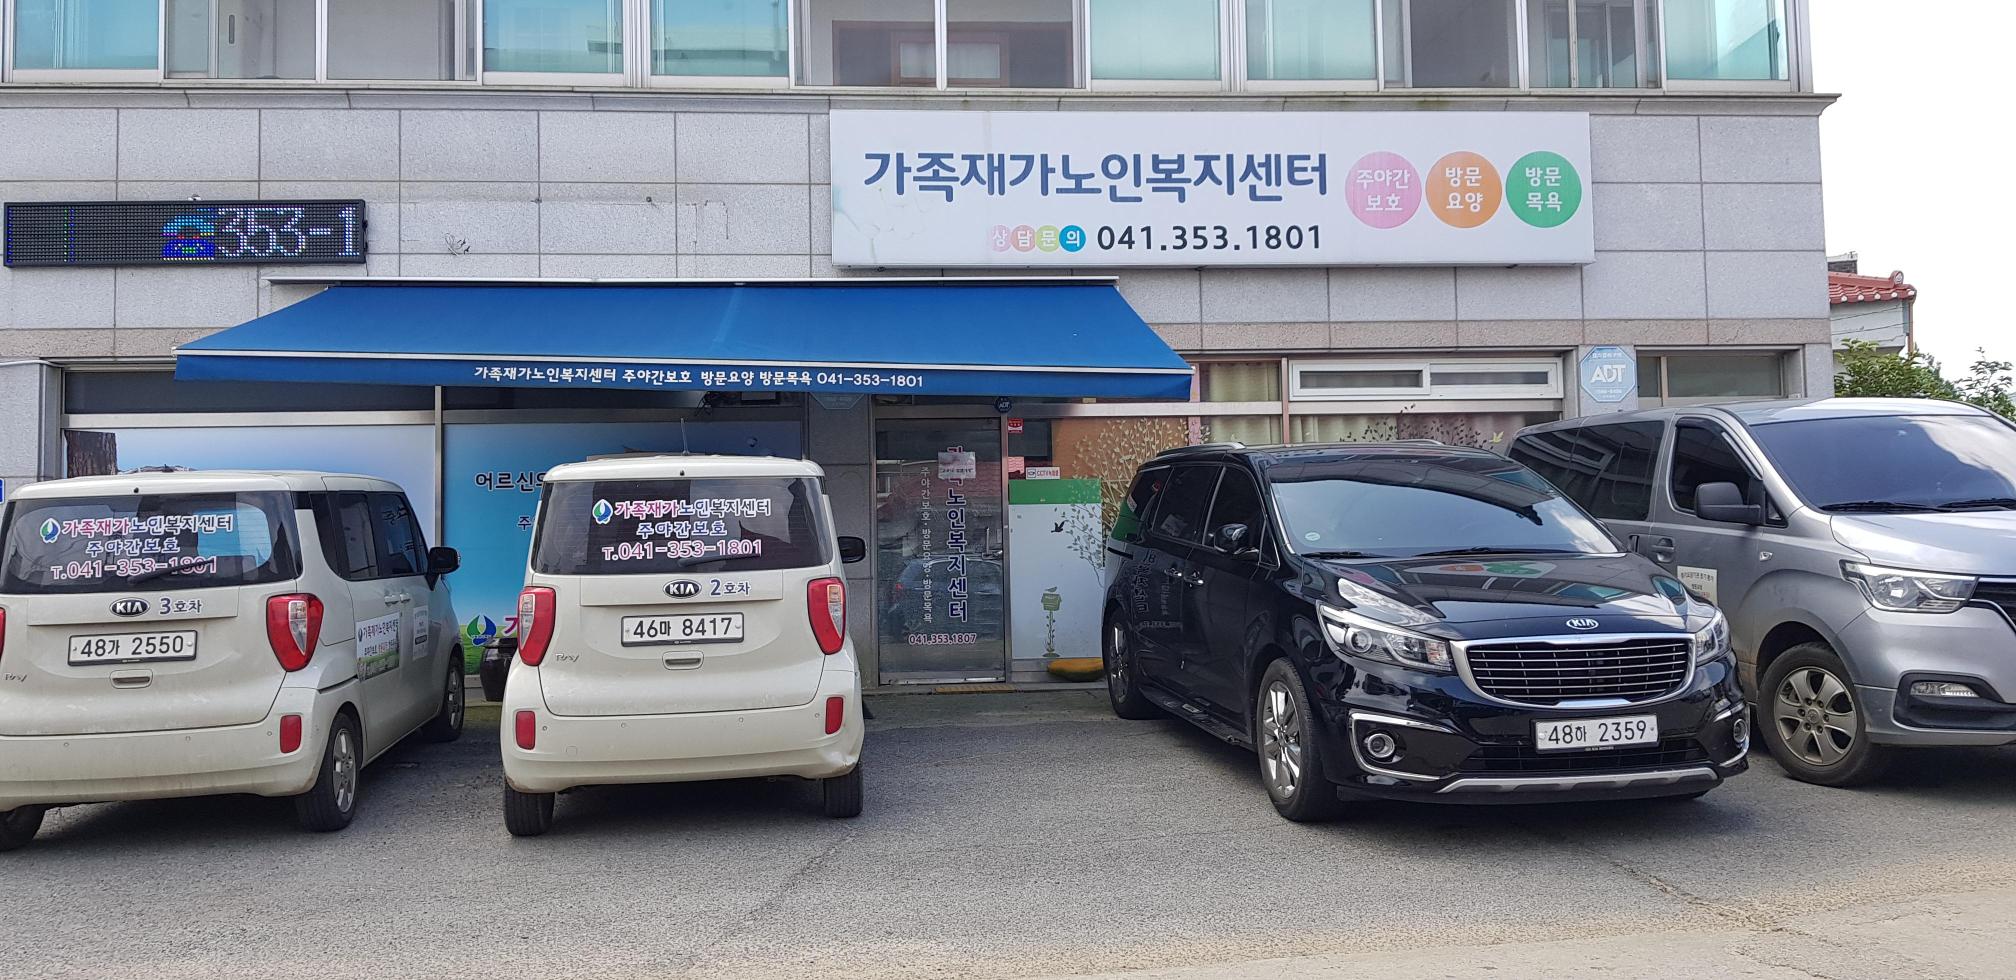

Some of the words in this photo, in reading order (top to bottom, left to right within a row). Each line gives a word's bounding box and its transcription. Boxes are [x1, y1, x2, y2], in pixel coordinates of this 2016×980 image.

[864, 152, 1327, 203] 가족재가노인복지센터
[1356, 169, 1411, 189] 주야간
[1445, 166, 1482, 188] 방문
[1525, 166, 1562, 188] 방문
[1365, 194, 1403, 212] 보호
[1446, 192, 1484, 213] 요양
[1526, 191, 1563, 213] 목욕
[218, 207, 360, 257] 353-1
[1097, 225, 1320, 251] 041.353.1801
[474, 366, 617, 383] 가족재가노인복지센터
[622, 368, 693, 386] 주야간보호
[701, 370, 755, 386] 방문요양
[759, 371, 813, 386] 방문목욕
[816, 372, 924, 388] 041-353-1801
[1590, 364, 1626, 383] ADT
[615, 499, 772, 520] 가족재가노인복지센터
[61, 513, 233, 538] 가족재가노인복지센터
[637, 520, 727, 540] 주야간보호
[86, 537, 181, 558] 주야간보호
[602, 539, 763, 561] T.041-353-1801
[669, 584, 695, 595] KIA
[116, 602, 144, 613] KIA
[633, 619, 672, 638] 46마
[682, 616, 733, 637] 8417
[1572, 618, 1595, 627] KIA
[80, 638, 121, 658] 48가
[131, 635, 185, 656] 2550
[1548, 725, 1588, 745] 48하
[1598, 720, 1647, 742] 2359
